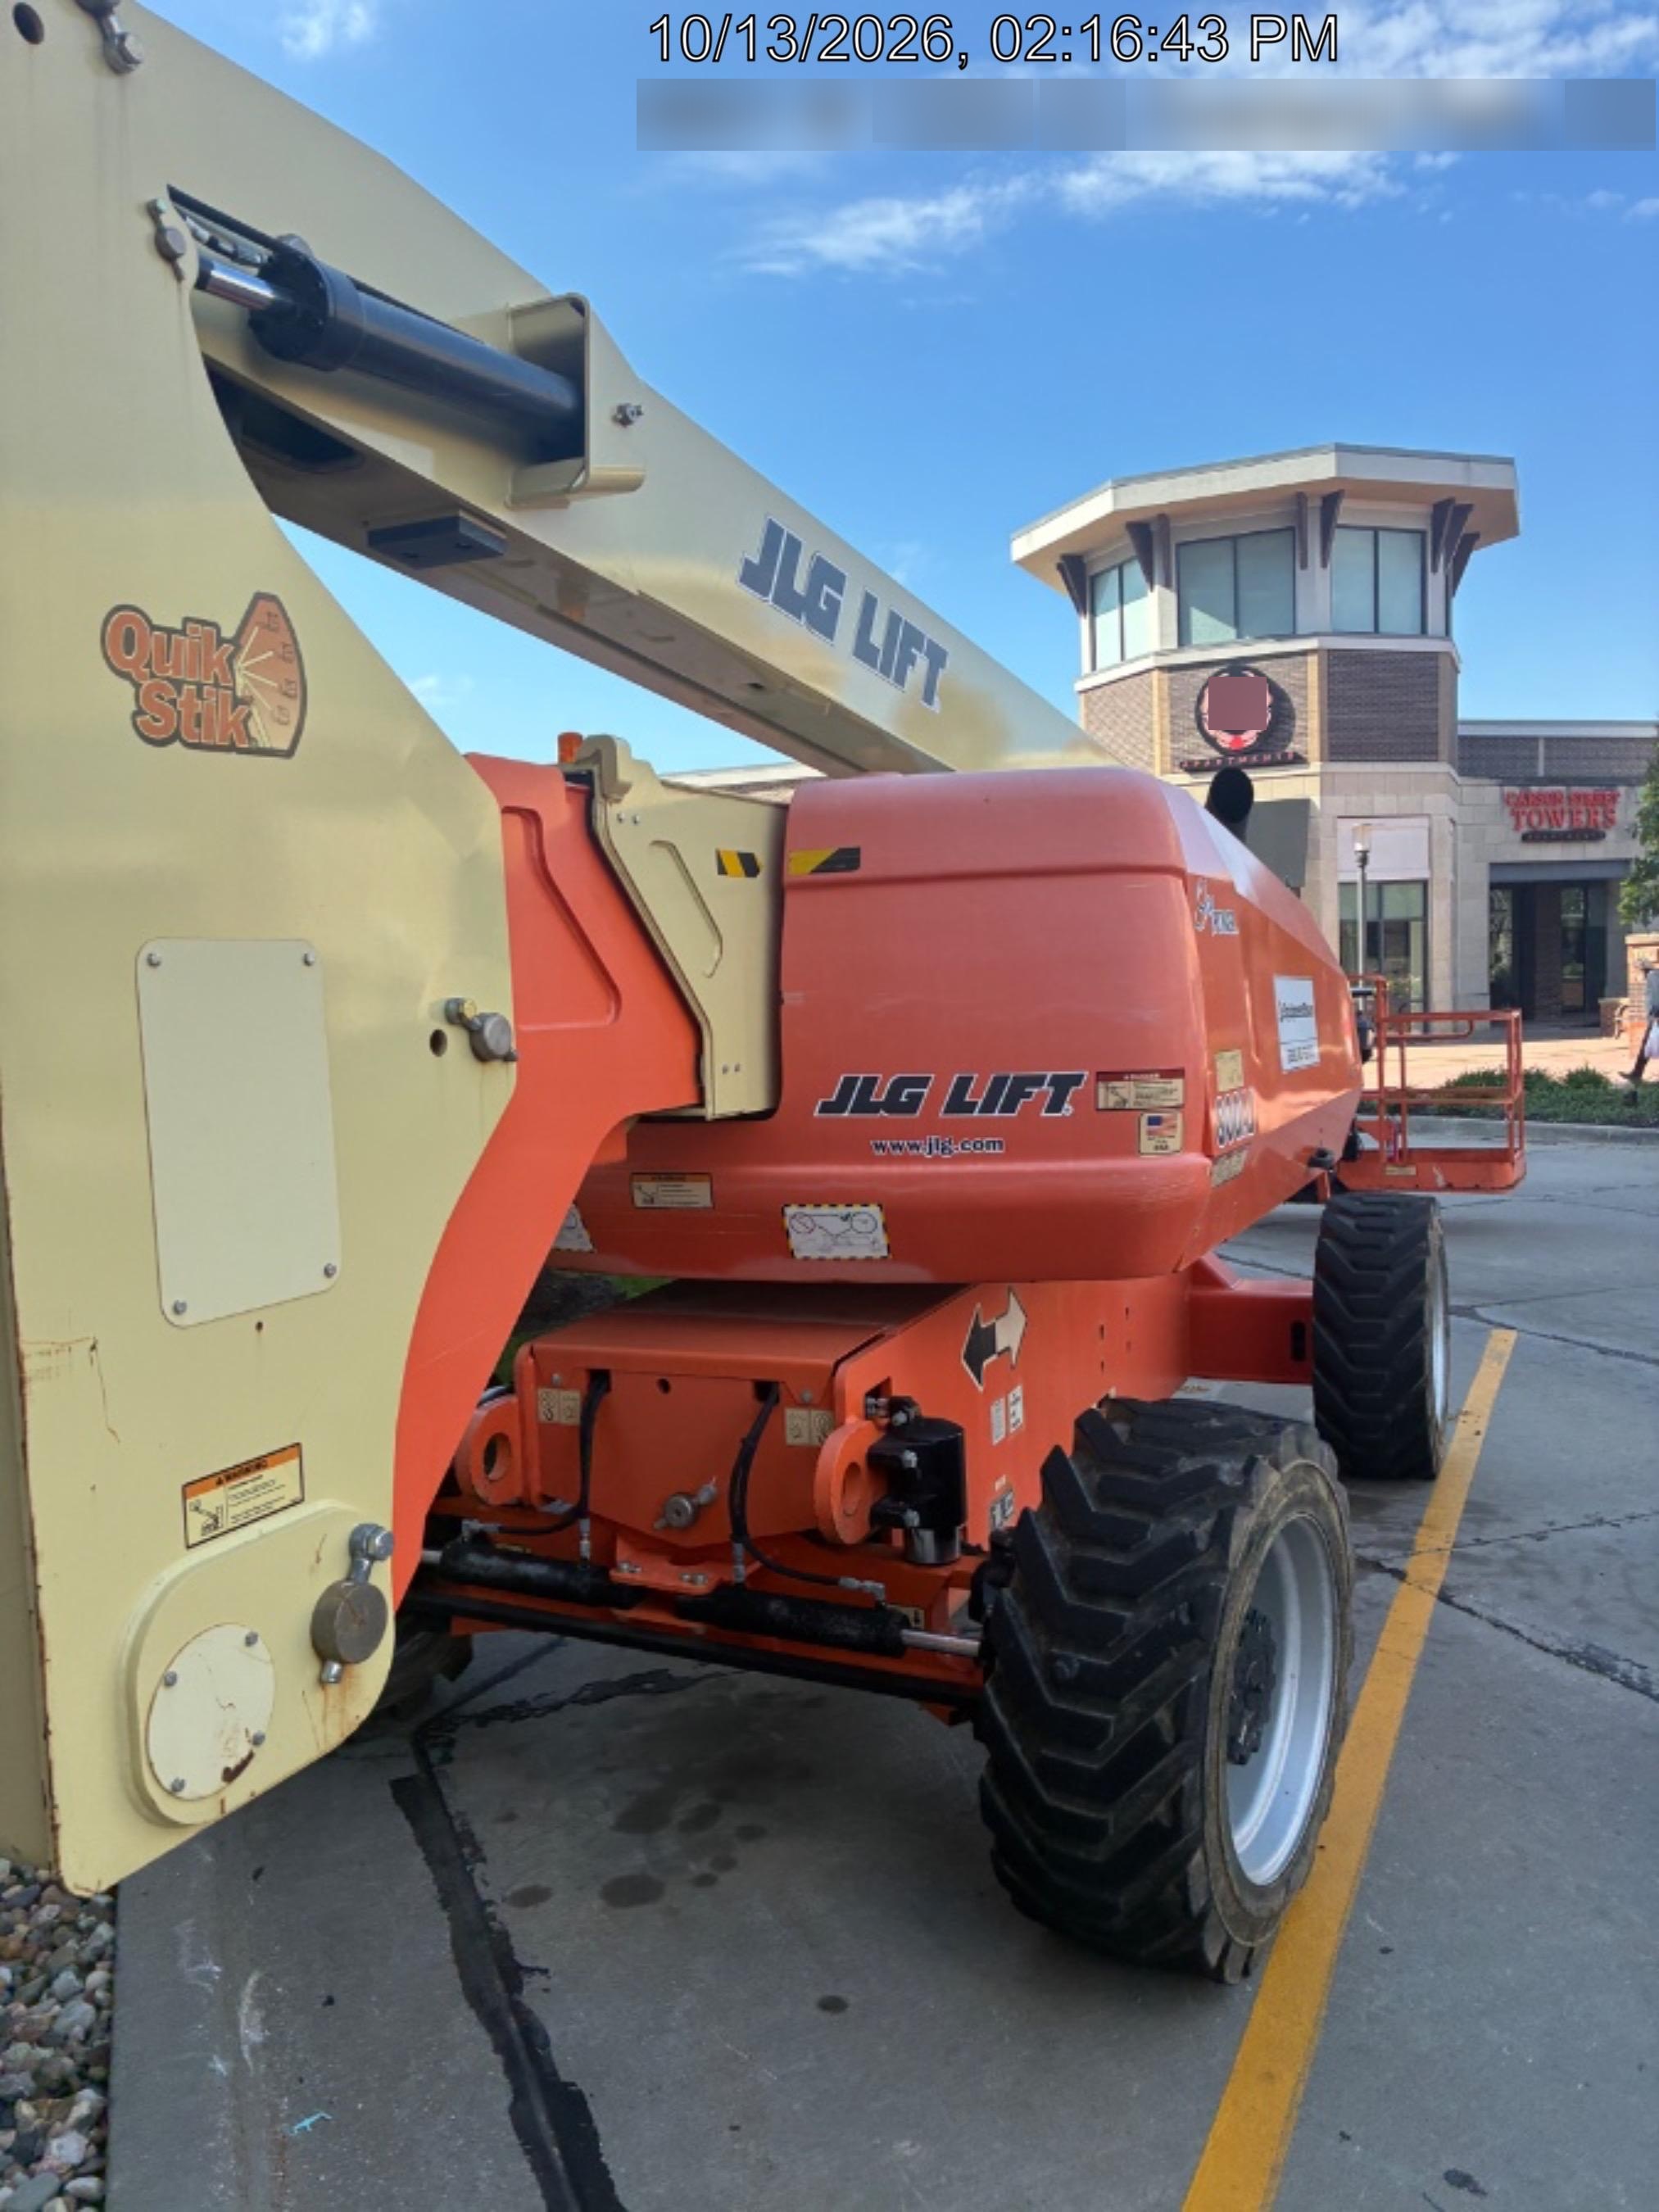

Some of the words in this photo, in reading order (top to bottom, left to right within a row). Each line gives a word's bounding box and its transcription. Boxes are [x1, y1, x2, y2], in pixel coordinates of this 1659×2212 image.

[738, 516, 847, 646] JLG
[851, 587, 949, 713] LIFT
[105, 610, 235, 687] Quik
[136, 678, 250, 748] Stik
[1510, 807, 1616, 832] TOWERS
[814, 1073, 936, 1117] JLG
[940, 1071, 1089, 1117] LIFT
[871, 1135, 1005, 1158] www.jlg.com
